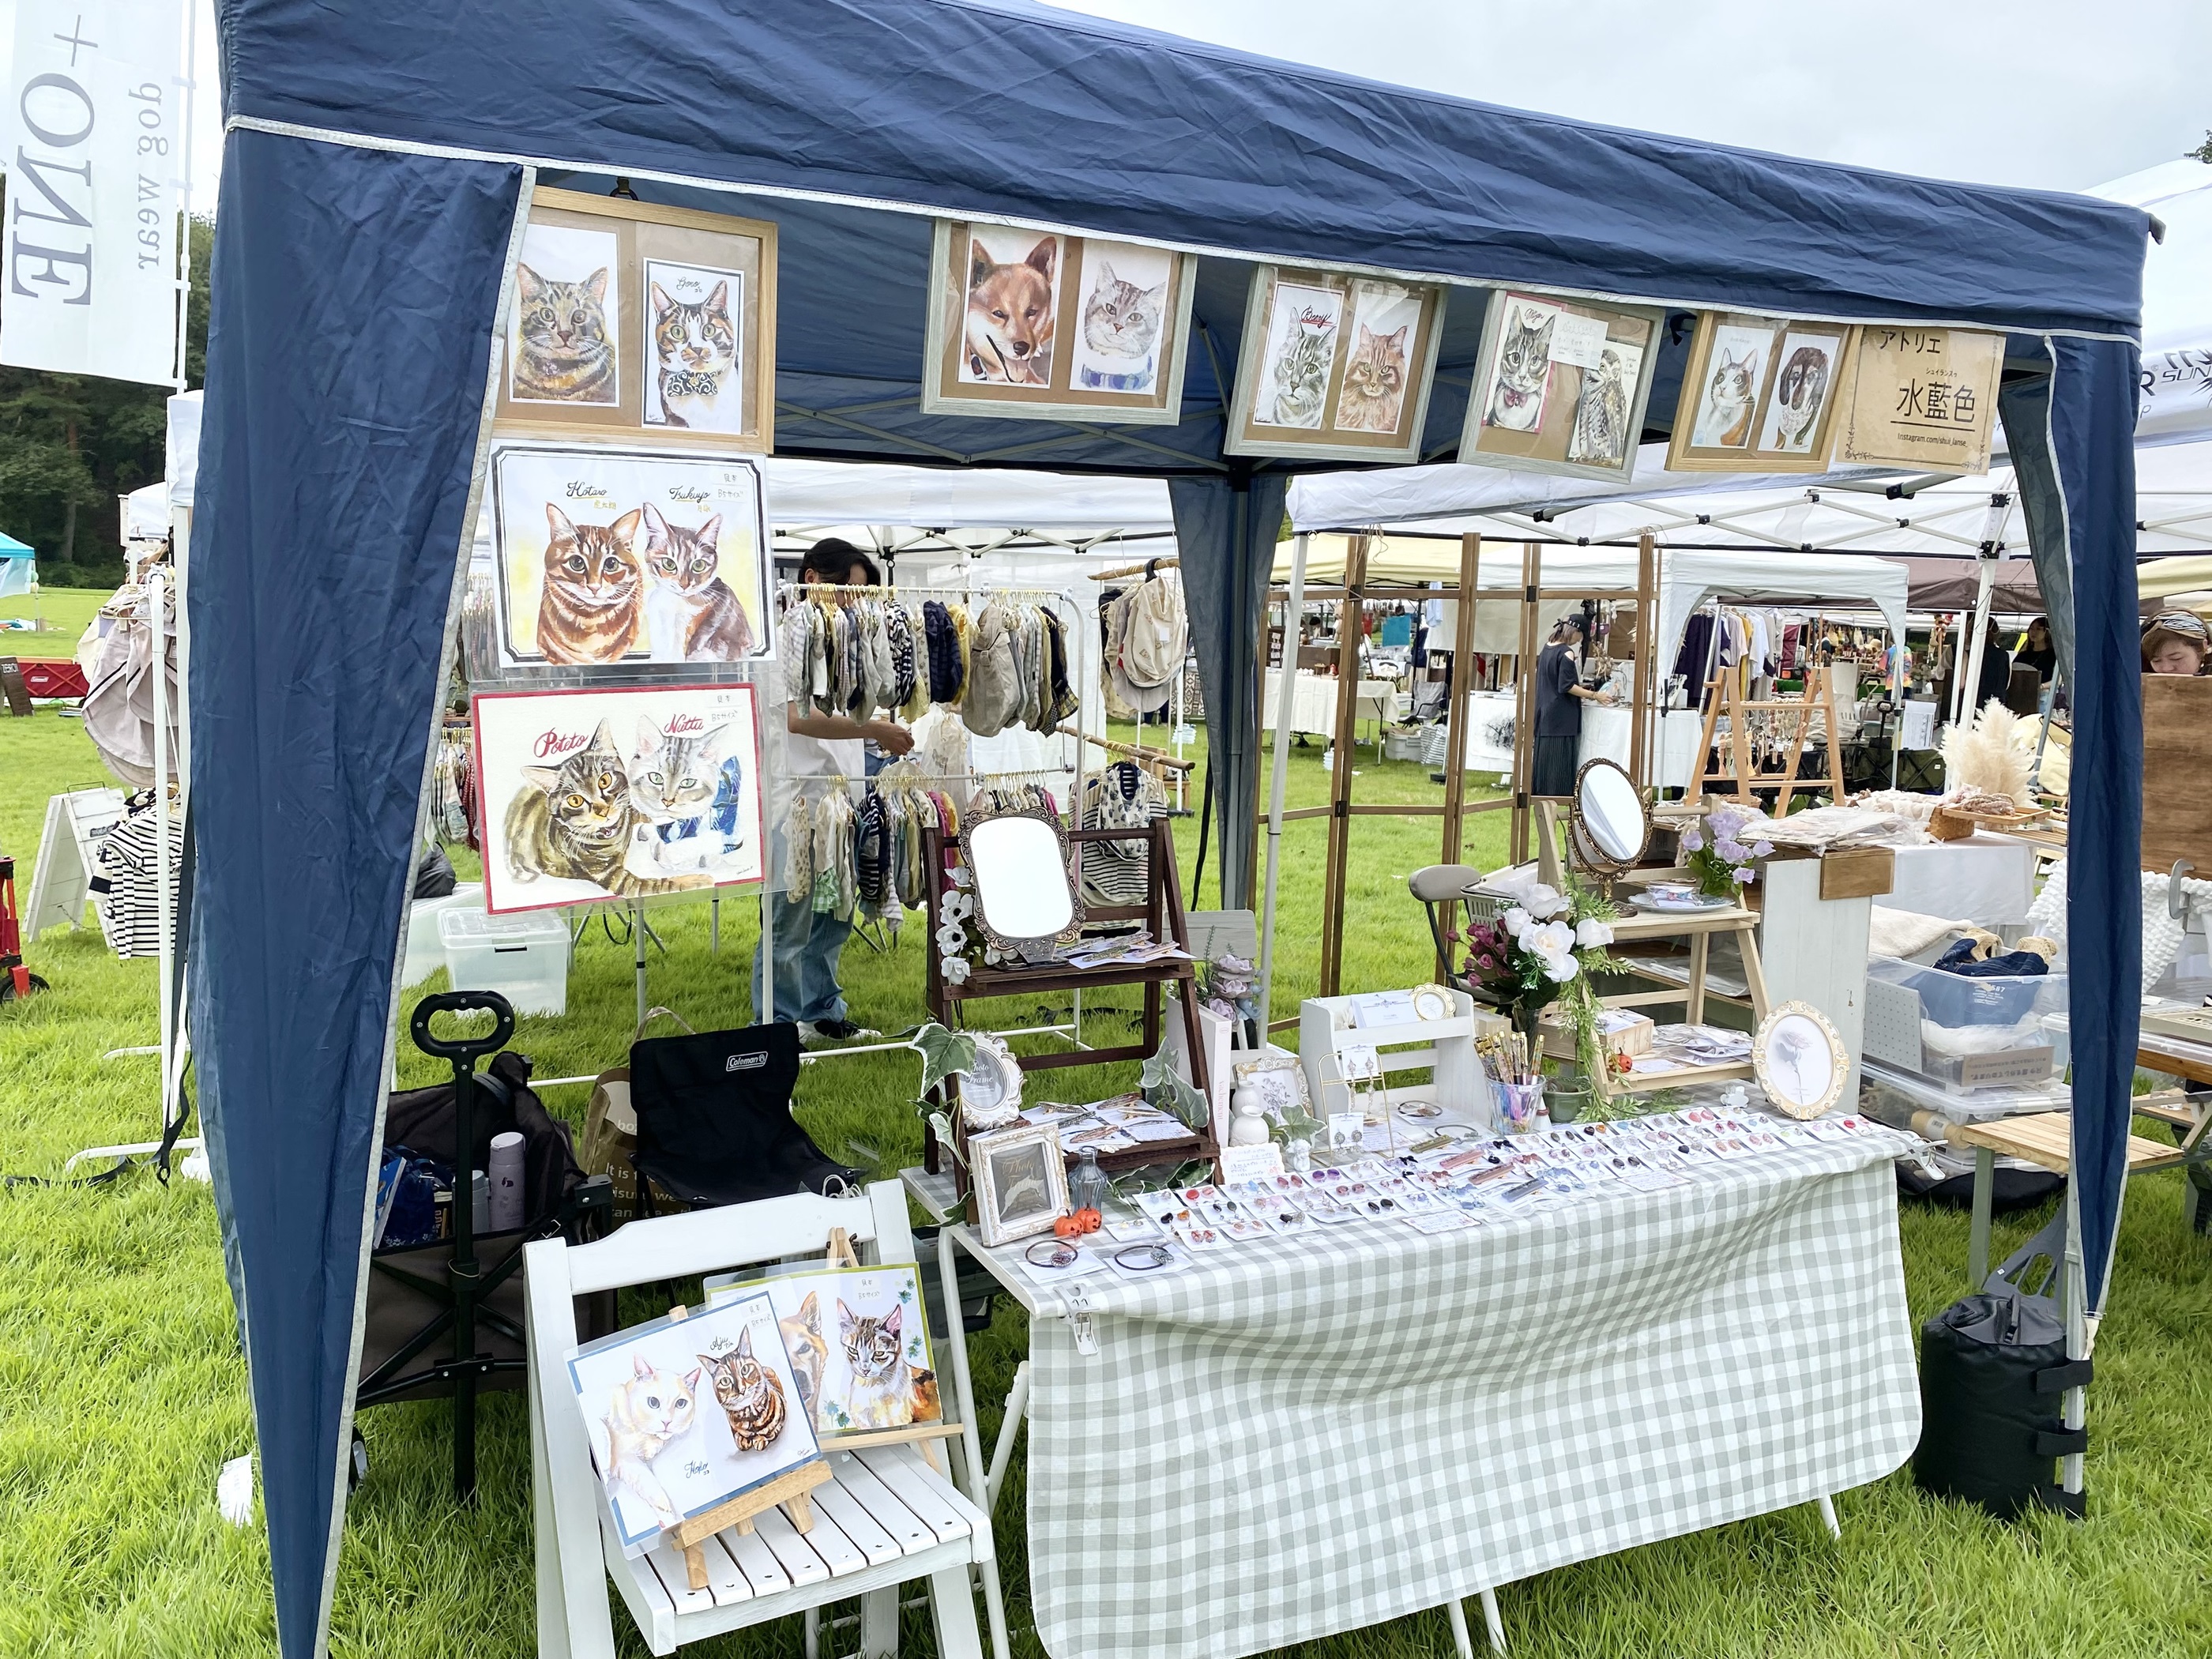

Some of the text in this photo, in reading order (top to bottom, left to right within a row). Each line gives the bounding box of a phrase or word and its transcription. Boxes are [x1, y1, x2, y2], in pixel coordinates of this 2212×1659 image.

[1879, 329, 1941, 354] アトリエ
[1896, 378, 1975, 423] 水藍色
[533, 727, 589, 758] Poteto
[729, 1057, 758, 1067] Coleman
[618, 1119, 637, 1131] bo
[606, 1162, 615, 1176] It
[618, 1167, 629, 1179] is
